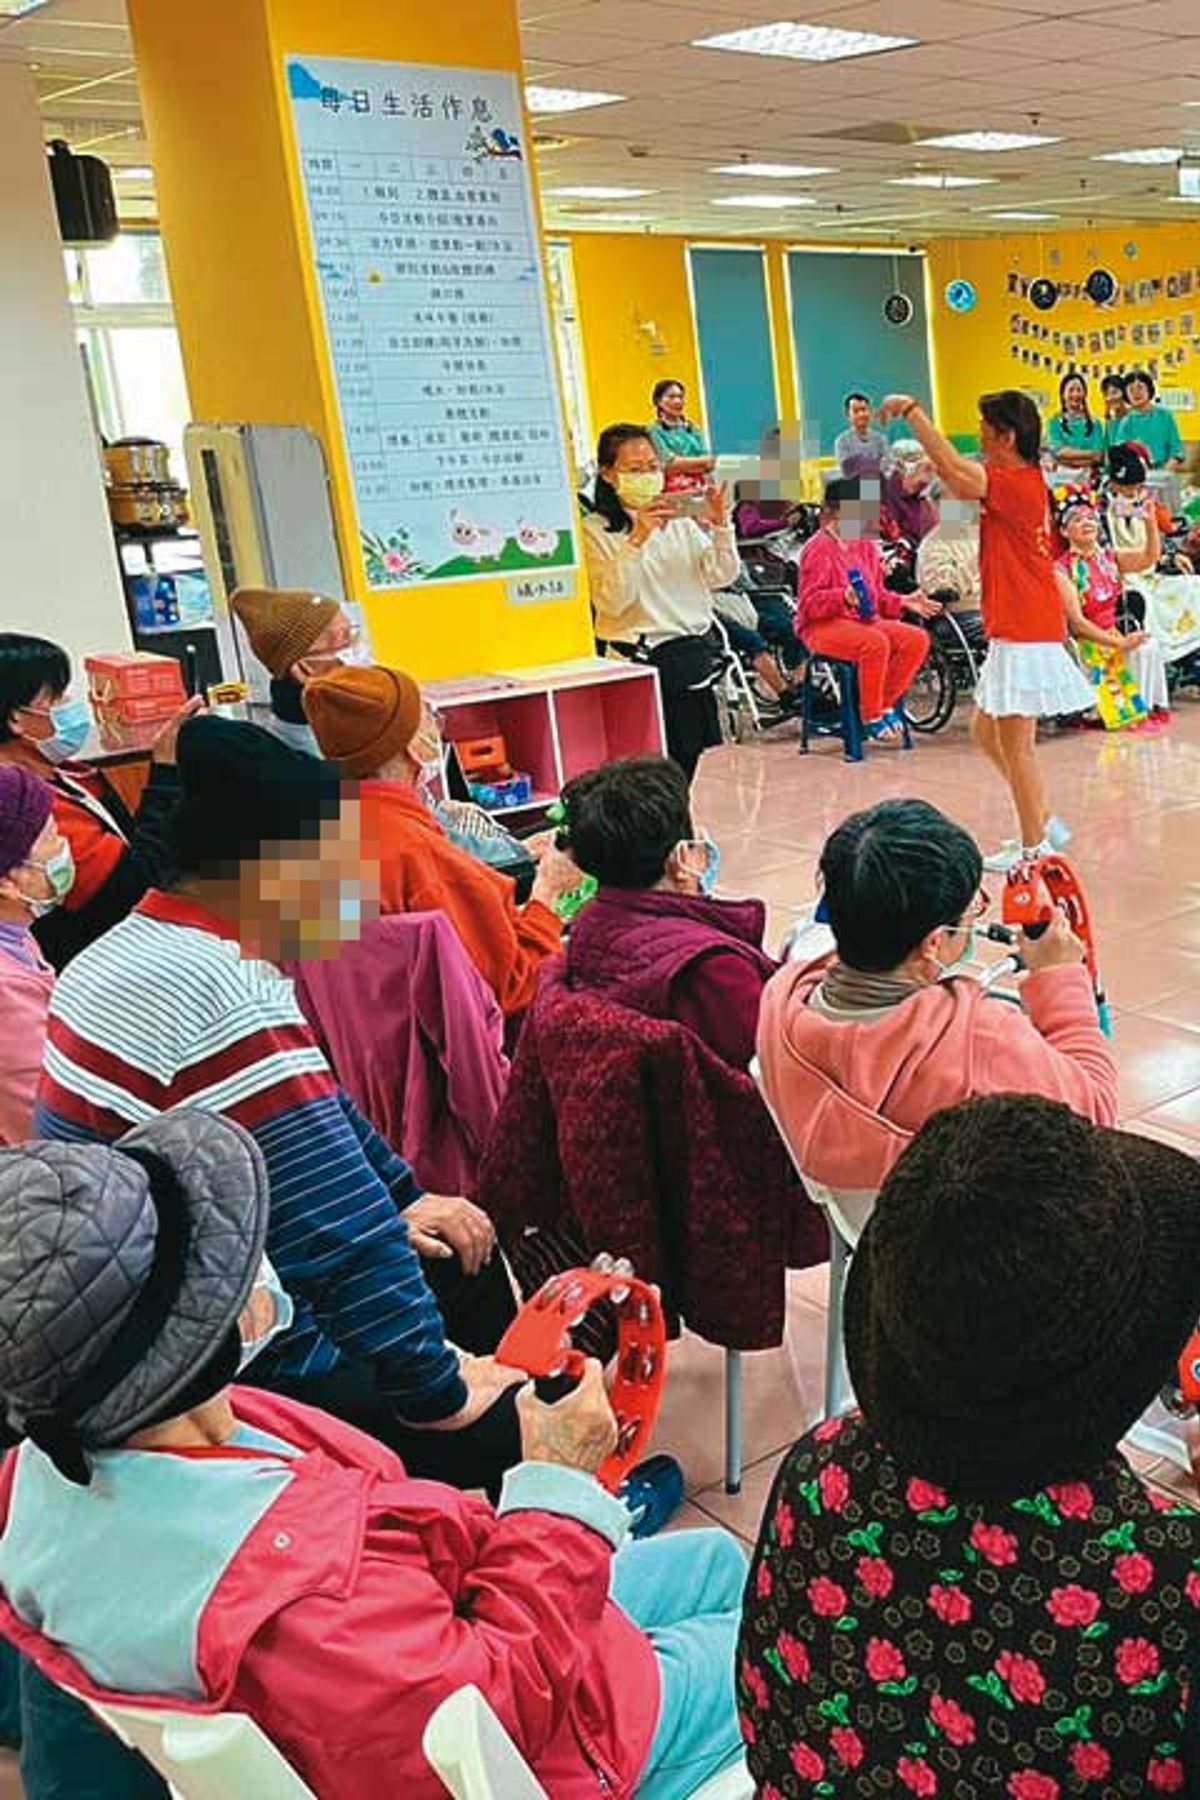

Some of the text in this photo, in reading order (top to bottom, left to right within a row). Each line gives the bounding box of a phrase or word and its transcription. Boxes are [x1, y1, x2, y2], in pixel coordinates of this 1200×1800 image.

[321, 86, 493, 123] 每日生活作息
